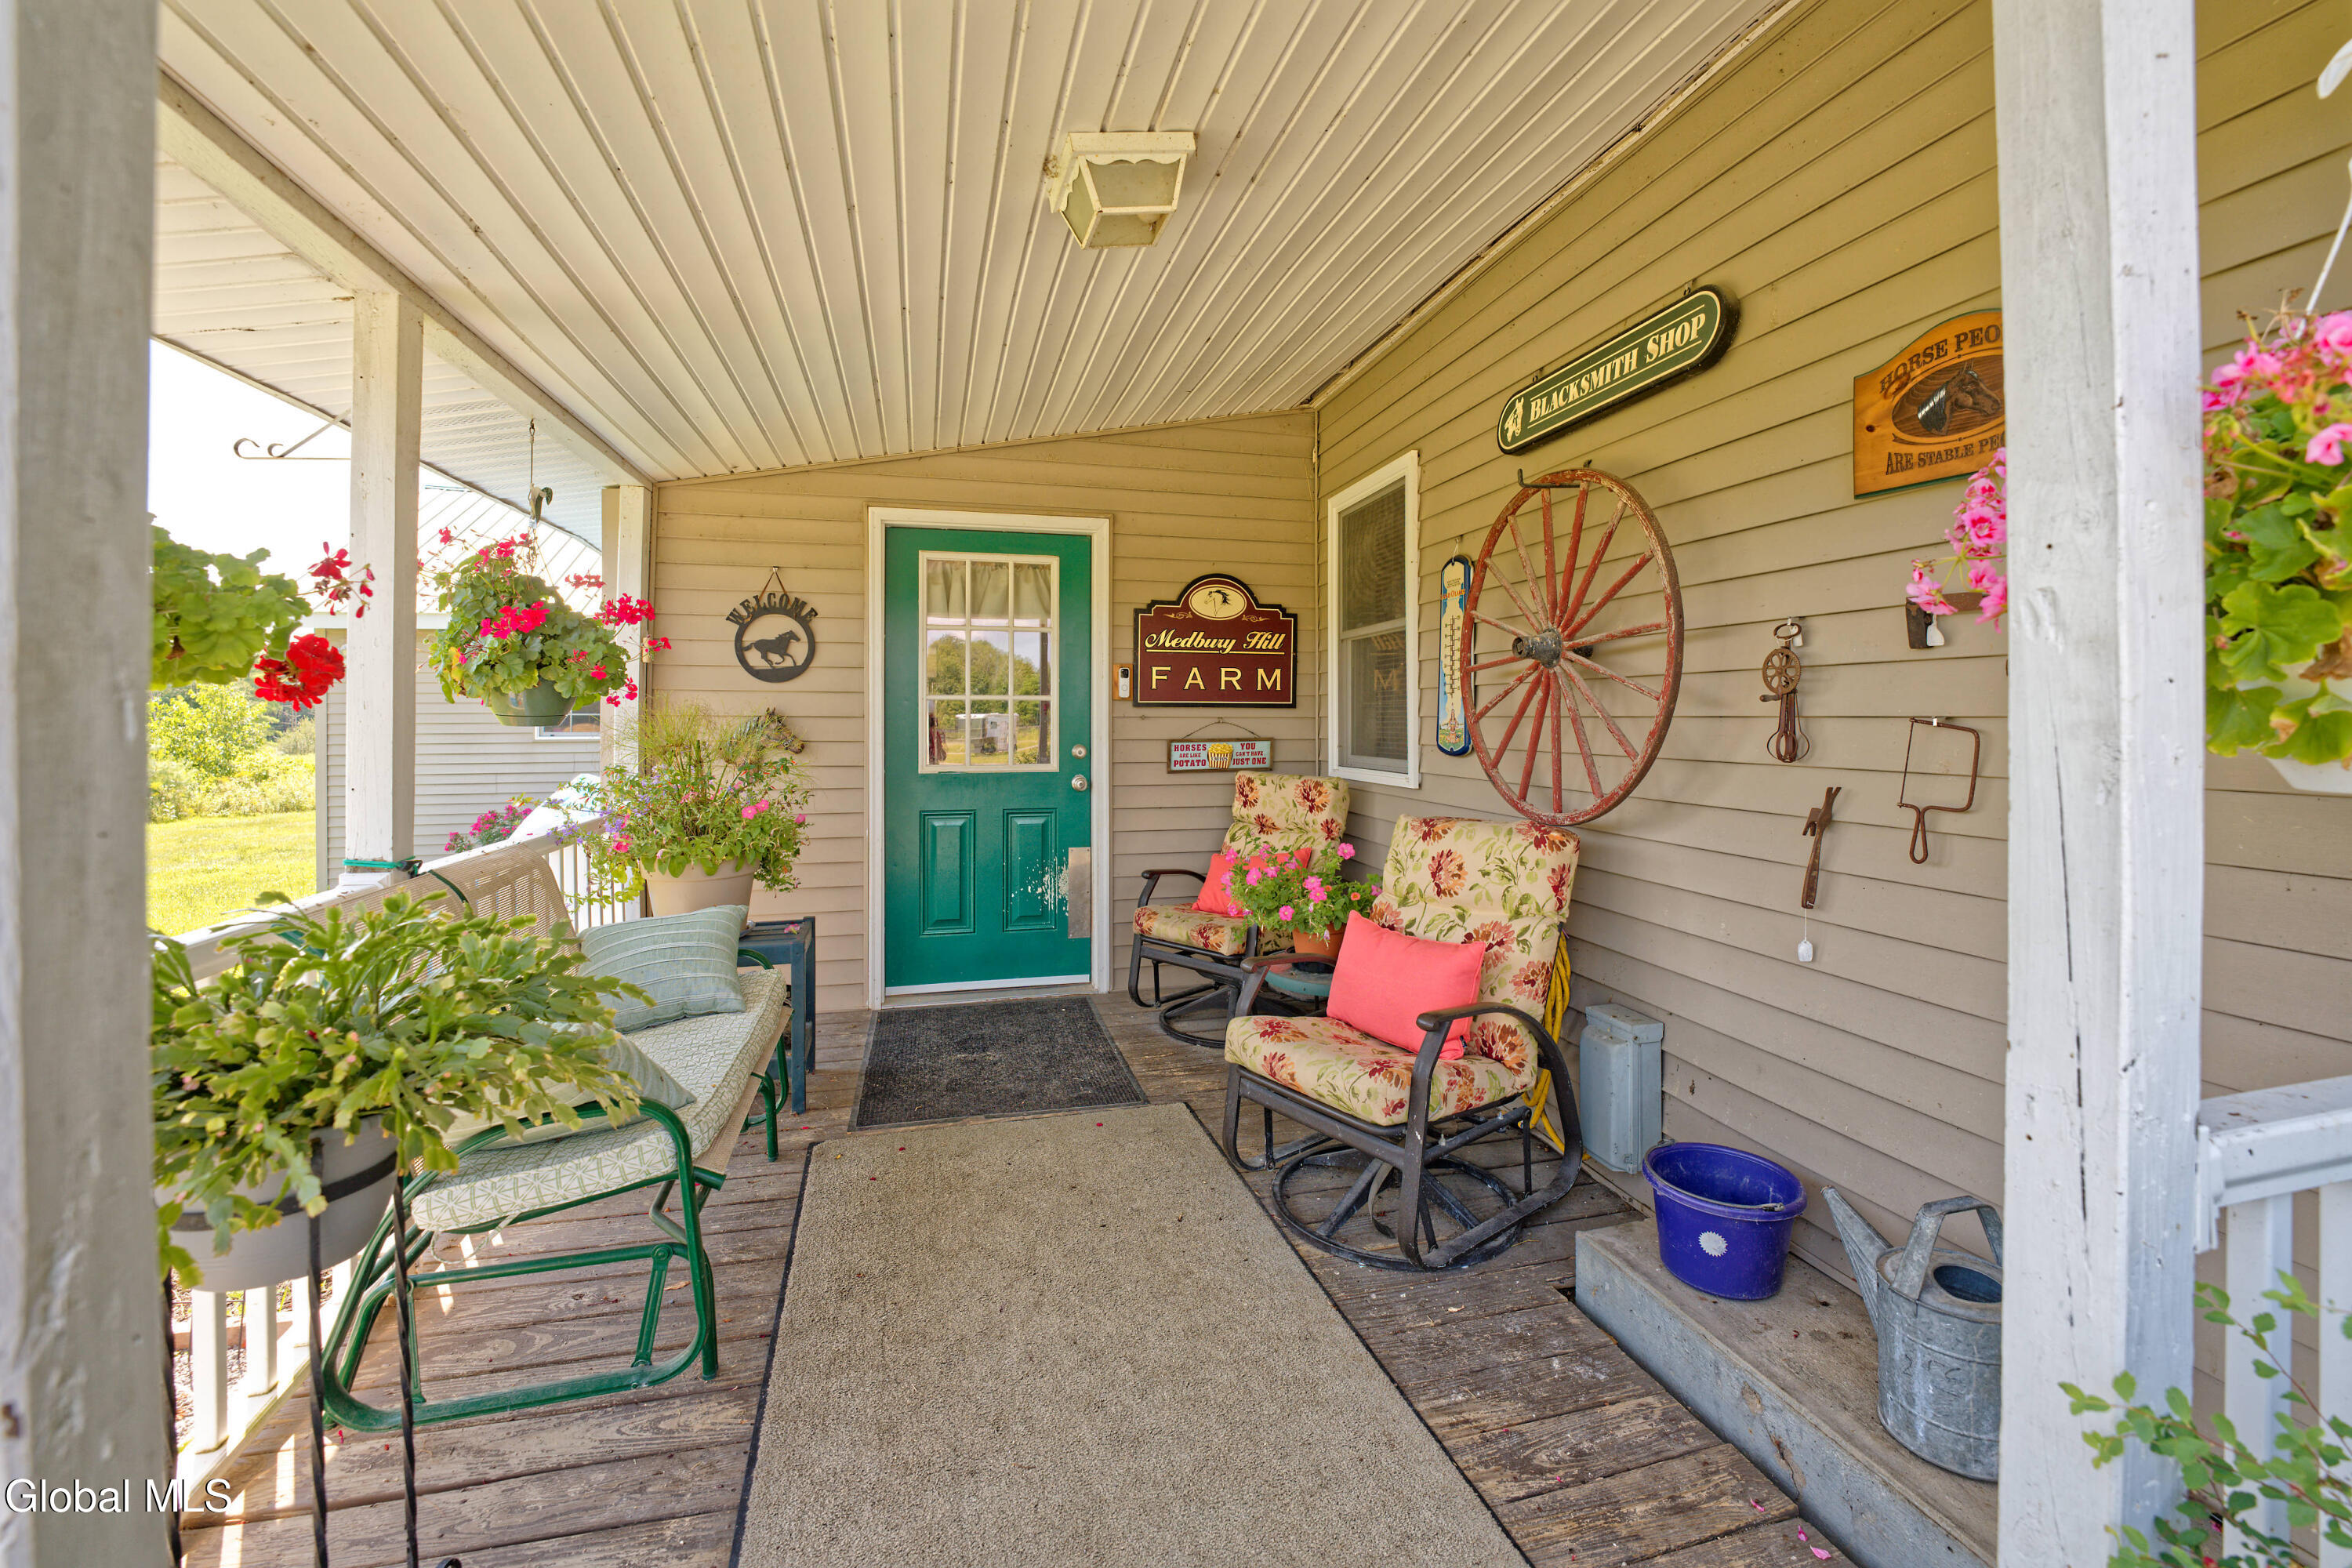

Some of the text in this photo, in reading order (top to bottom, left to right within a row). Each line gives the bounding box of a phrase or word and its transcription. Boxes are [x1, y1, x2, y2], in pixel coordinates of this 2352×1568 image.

[1529, 313, 1706, 423] BLACKSMITH SHOP
[1879, 323, 2002, 394] HORSE PEO
[1886, 452, 1914, 475] ARE
[1918, 440, 1974, 468] STABLE
[725, 592, 818, 626] WELCOME
[1145, 629, 1287, 655] Medbury Hill
[1151, 666, 1282, 691] FARM
[1174, 759, 1207, 768] POTATO
